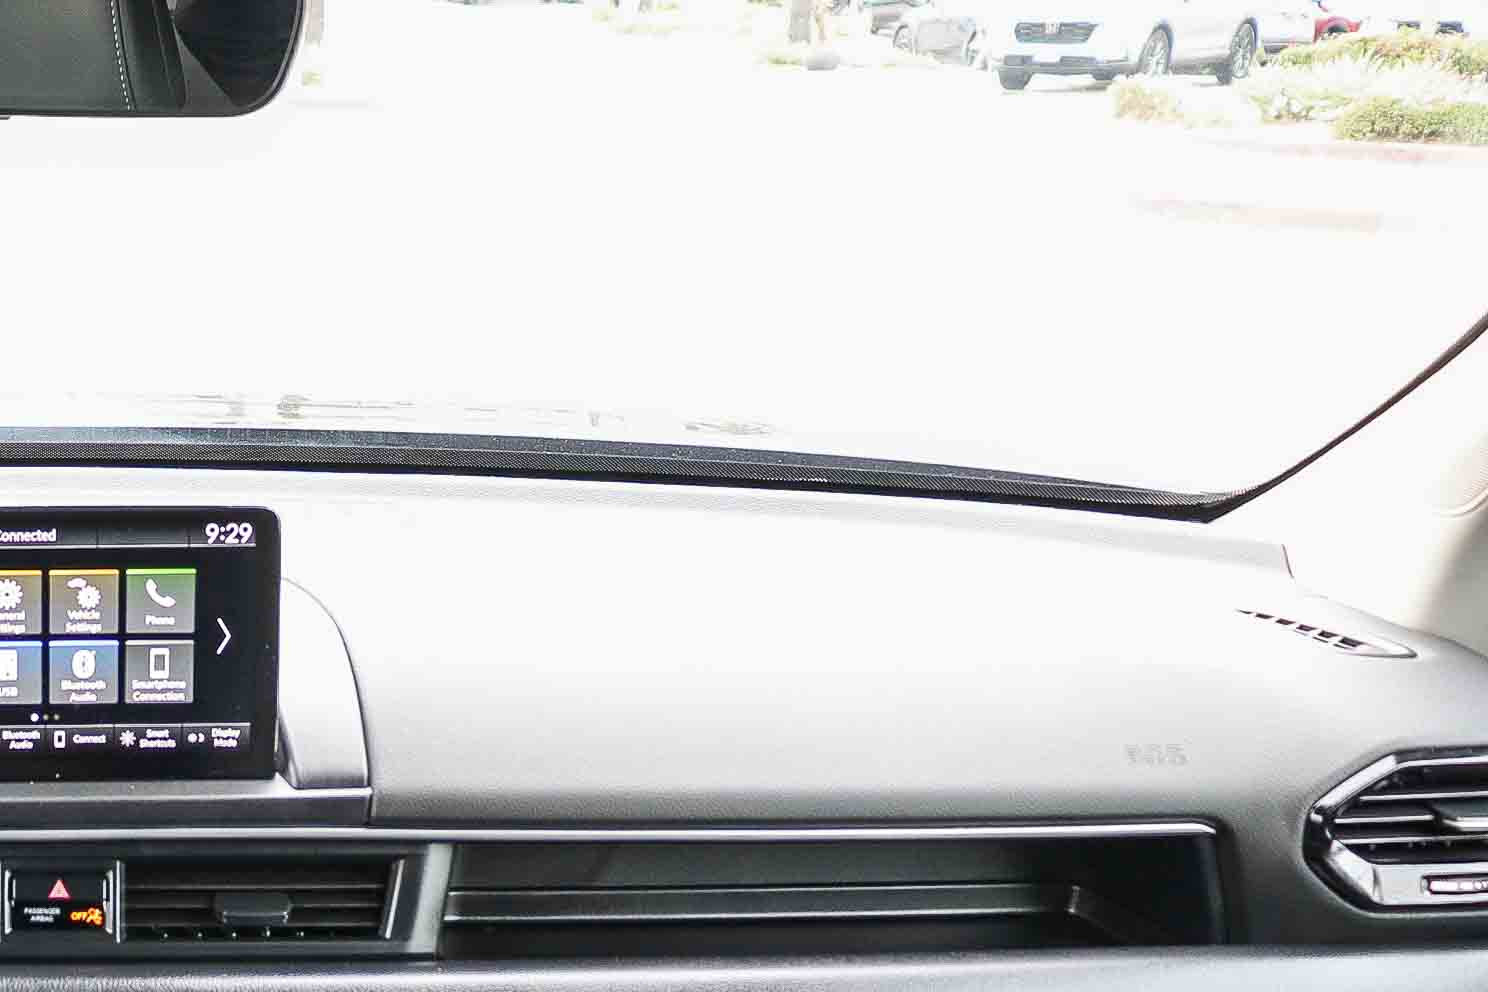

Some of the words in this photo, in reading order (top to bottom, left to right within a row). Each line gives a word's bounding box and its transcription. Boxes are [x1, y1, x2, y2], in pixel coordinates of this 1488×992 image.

[205, 522, 253, 544] 9:29
[67, 609, 101, 620] Vehicle
[145, 615, 176, 625] Phone
[72, 734, 107, 744] Connect
